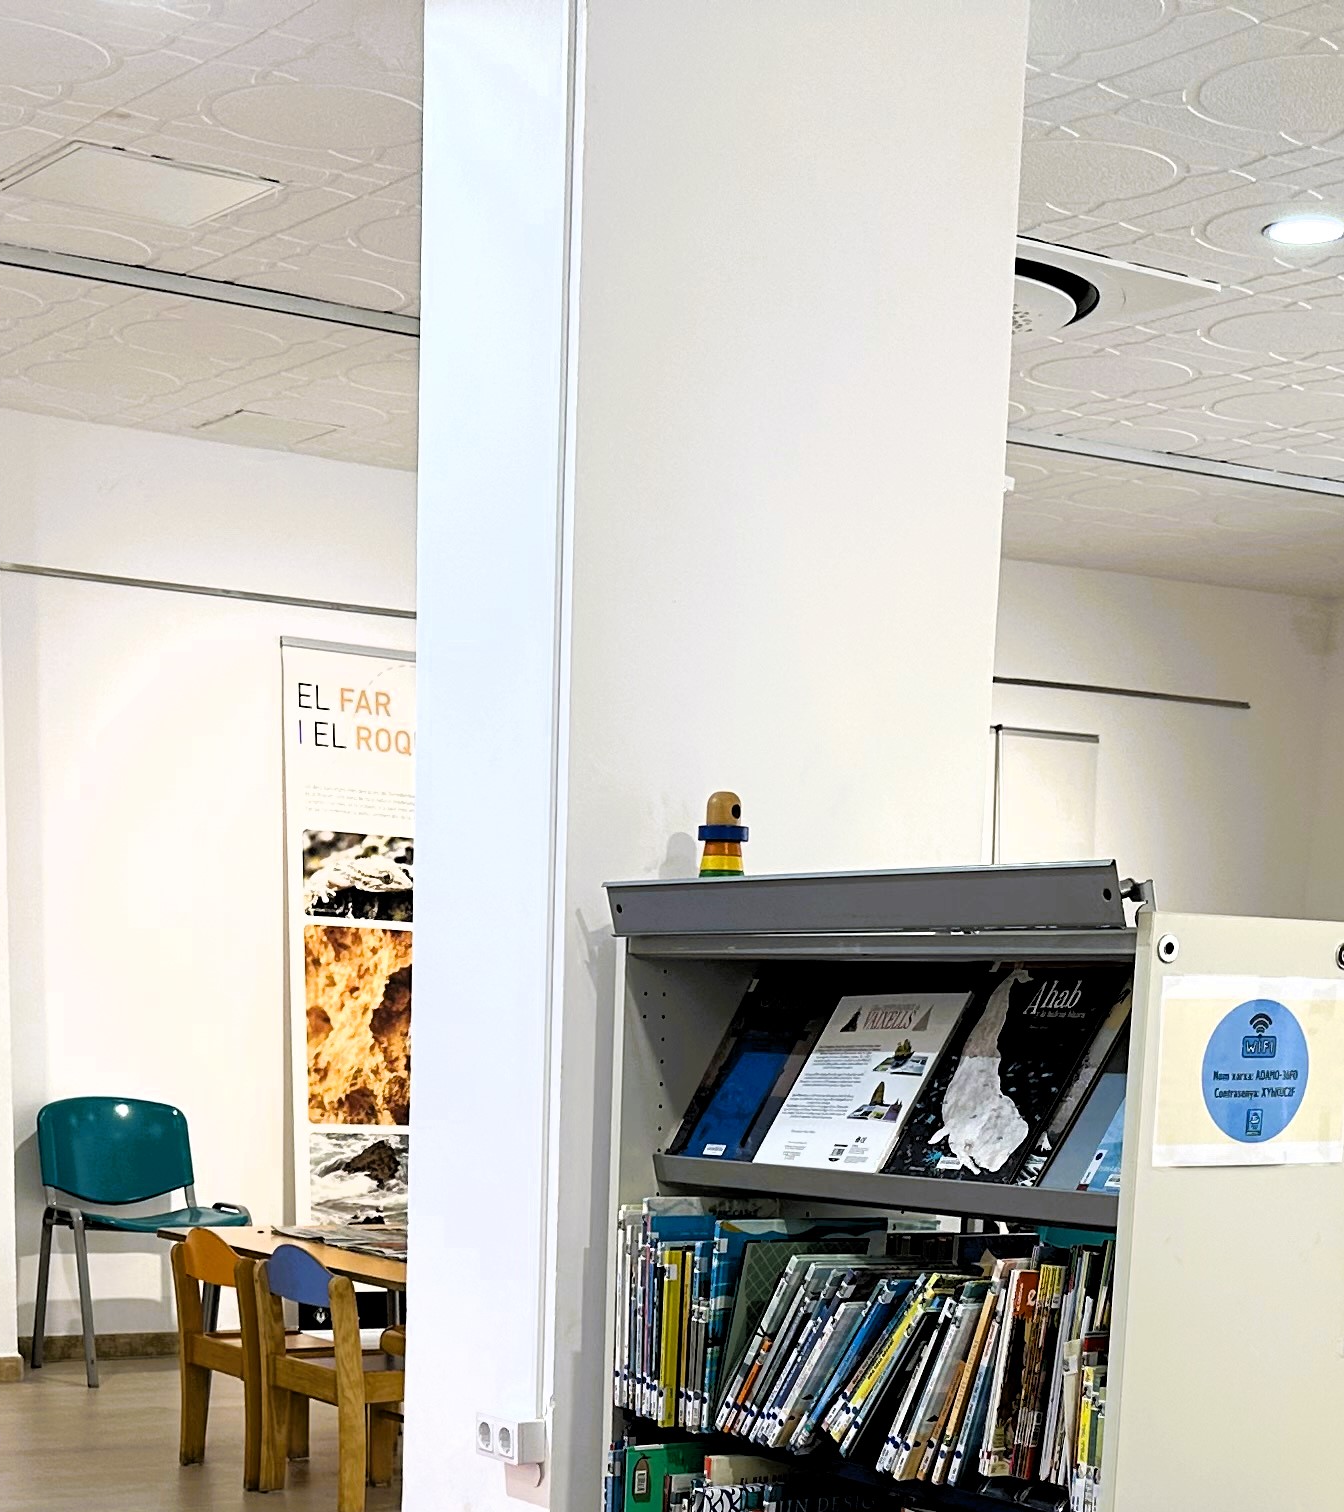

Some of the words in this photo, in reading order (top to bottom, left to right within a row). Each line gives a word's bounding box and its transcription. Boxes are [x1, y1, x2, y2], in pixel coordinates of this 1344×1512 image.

[297, 682, 331, 711] EL
[340, 687, 392, 717] FAR
[298, 719, 303, 745] I
[314, 720, 348, 749] EL
[356, 725, 417, 757] ROQ
[1023, 979, 1083, 1015] Ahab
[862, 1009, 914, 1031] VAIXELLS
